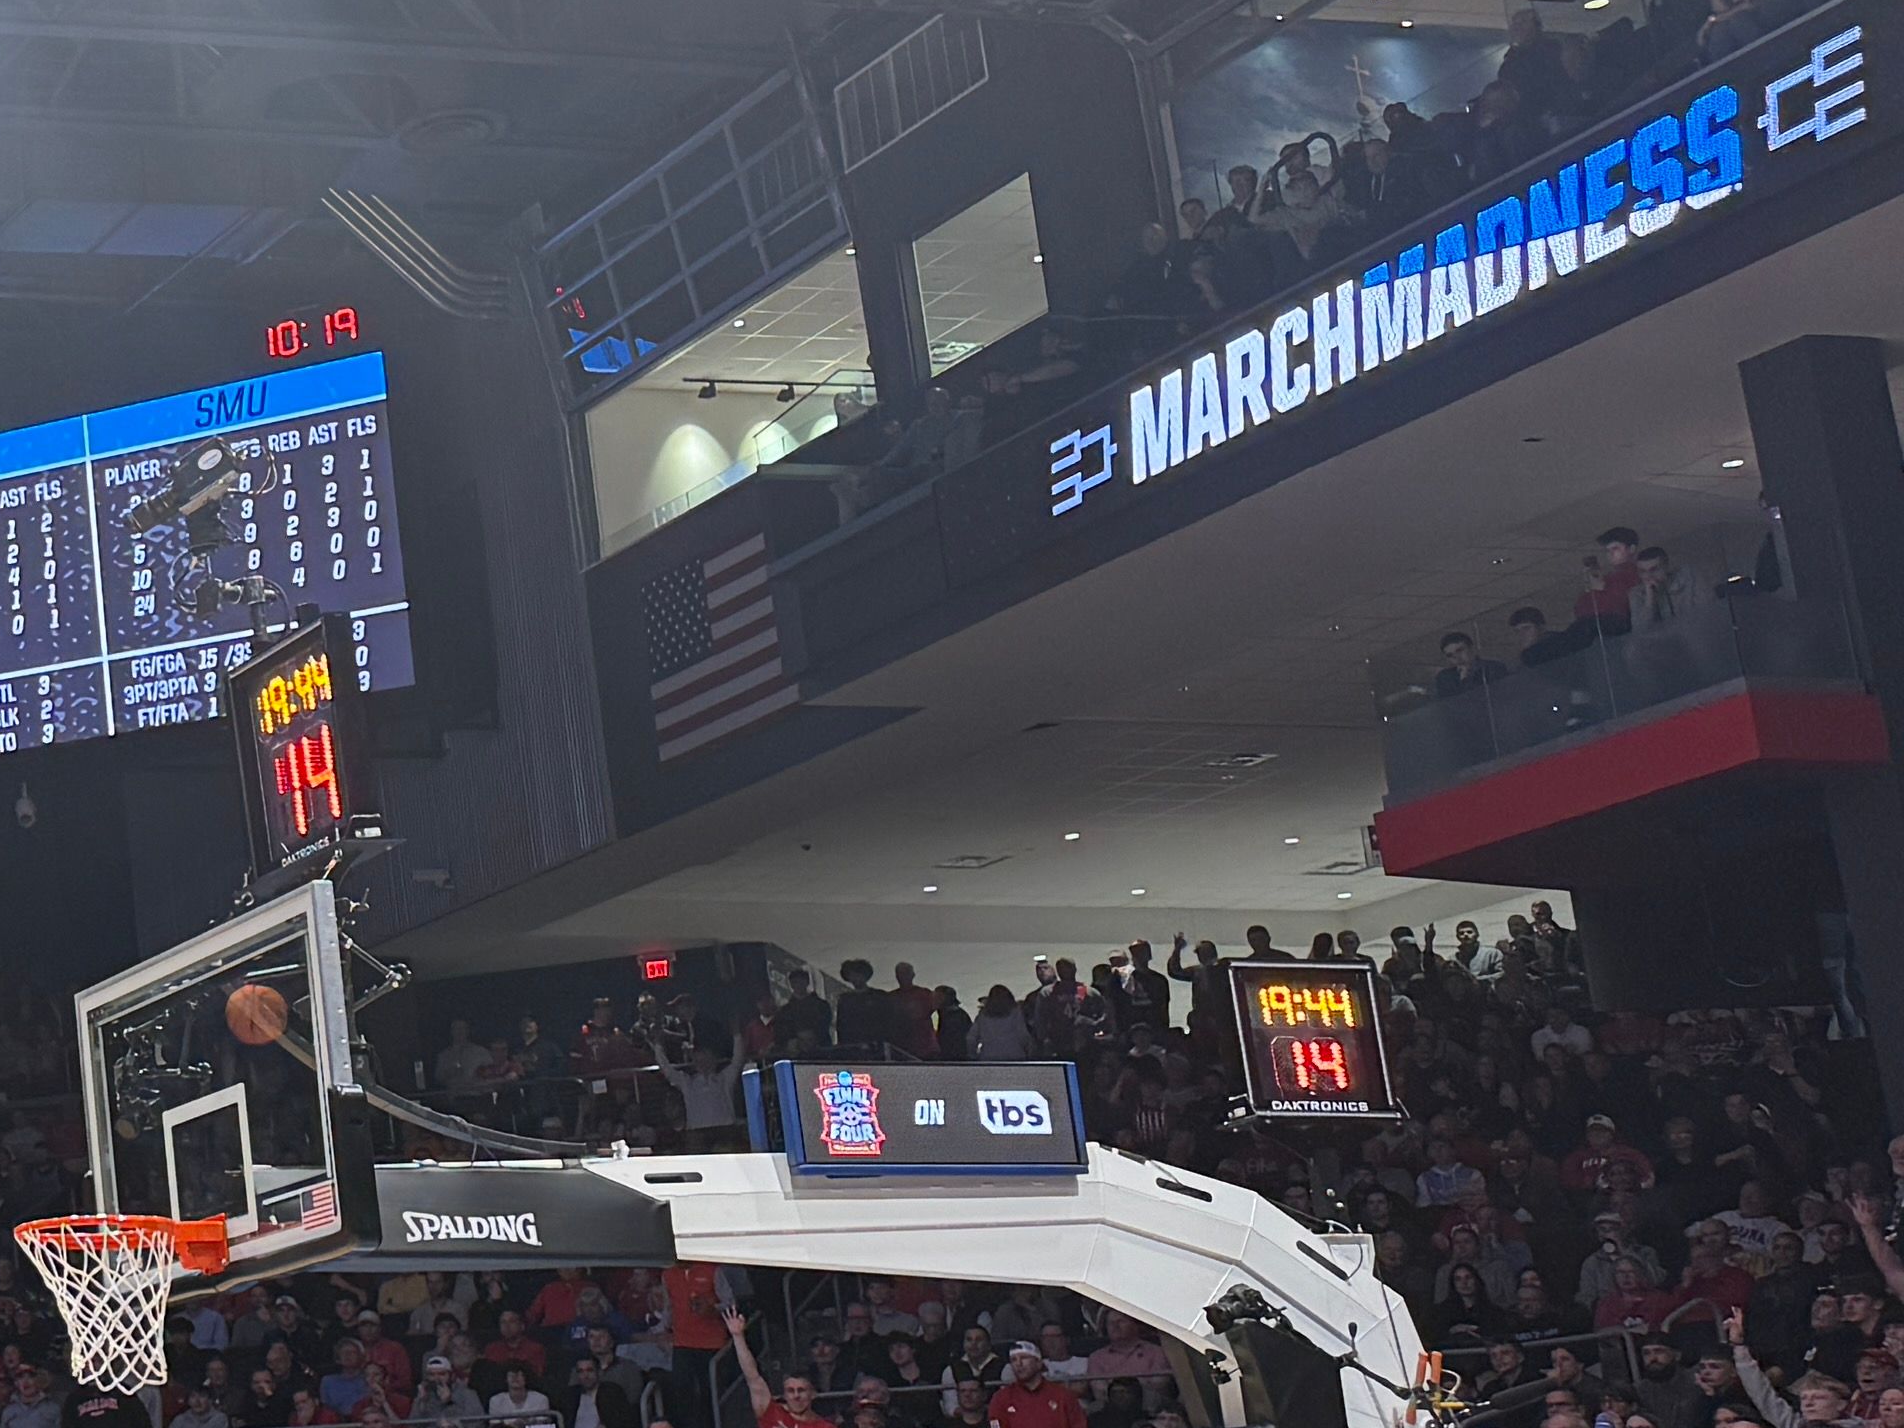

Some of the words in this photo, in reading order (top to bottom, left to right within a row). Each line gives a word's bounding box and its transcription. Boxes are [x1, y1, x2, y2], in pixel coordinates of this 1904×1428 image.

[265, 307, 360, 358] 10:19
[195, 380, 269, 430] SMU
[105, 458, 161, 488] PLAYER
[267, 430, 301, 453] REB
[308, 421, 339, 447] AST
[347, 414, 378, 439] FLS
[282, 463, 293, 485] 1
[321, 454, 335, 477] 3
[359, 448, 371, 471] 1
[0, 485, 28, 508] AST
[34, 479, 63, 502] FLS
[283, 489, 297, 511] 0
[324, 482, 338, 504] 2
[363, 476, 374, 498] 1
[7, 519, 17, 540] 1
[40, 512, 54, 534] 2
[133, 543, 147, 566] 5
[286, 515, 300, 537] 2
[327, 506, 341, 529] 3
[364, 500, 378, 522] 0
[6, 544, 20, 565] 2
[43, 536, 54, 558] 1
[131, 569, 153, 592] 10
[330, 532, 344, 554] 0
[367, 526, 381, 548] 0
[7, 565, 21, 588] 4
[43, 559, 57, 580] 0
[133, 594, 156, 618] 24
[292, 566, 306, 589] 4
[332, 558, 346, 581] 0
[371, 552, 383, 575] 1
[12, 589, 22, 611] 1
[46, 582, 57, 604] 1
[11, 614, 25, 636] 0
[49, 608, 60, 630] 1
[131, 652, 187, 679] FG/FGA
[198, 648, 219, 671] 15
[355, 645, 369, 668] 0
[40, 699, 54, 721] 2
[137, 703, 190, 729] FT/FTA
[1258, 984, 1358, 1028] 19:44
[1291, 1038, 1350, 1092] 14
[823, 1087, 873, 1106] FINAL
[1271, 1098, 1370, 1115] DAKTRONICS
[914, 1099, 945, 1126] ON
[987, 1098, 1045, 1128] tbs
[830, 1124, 876, 1143] FOUR
[403, 1211, 544, 1248] SPALDING
